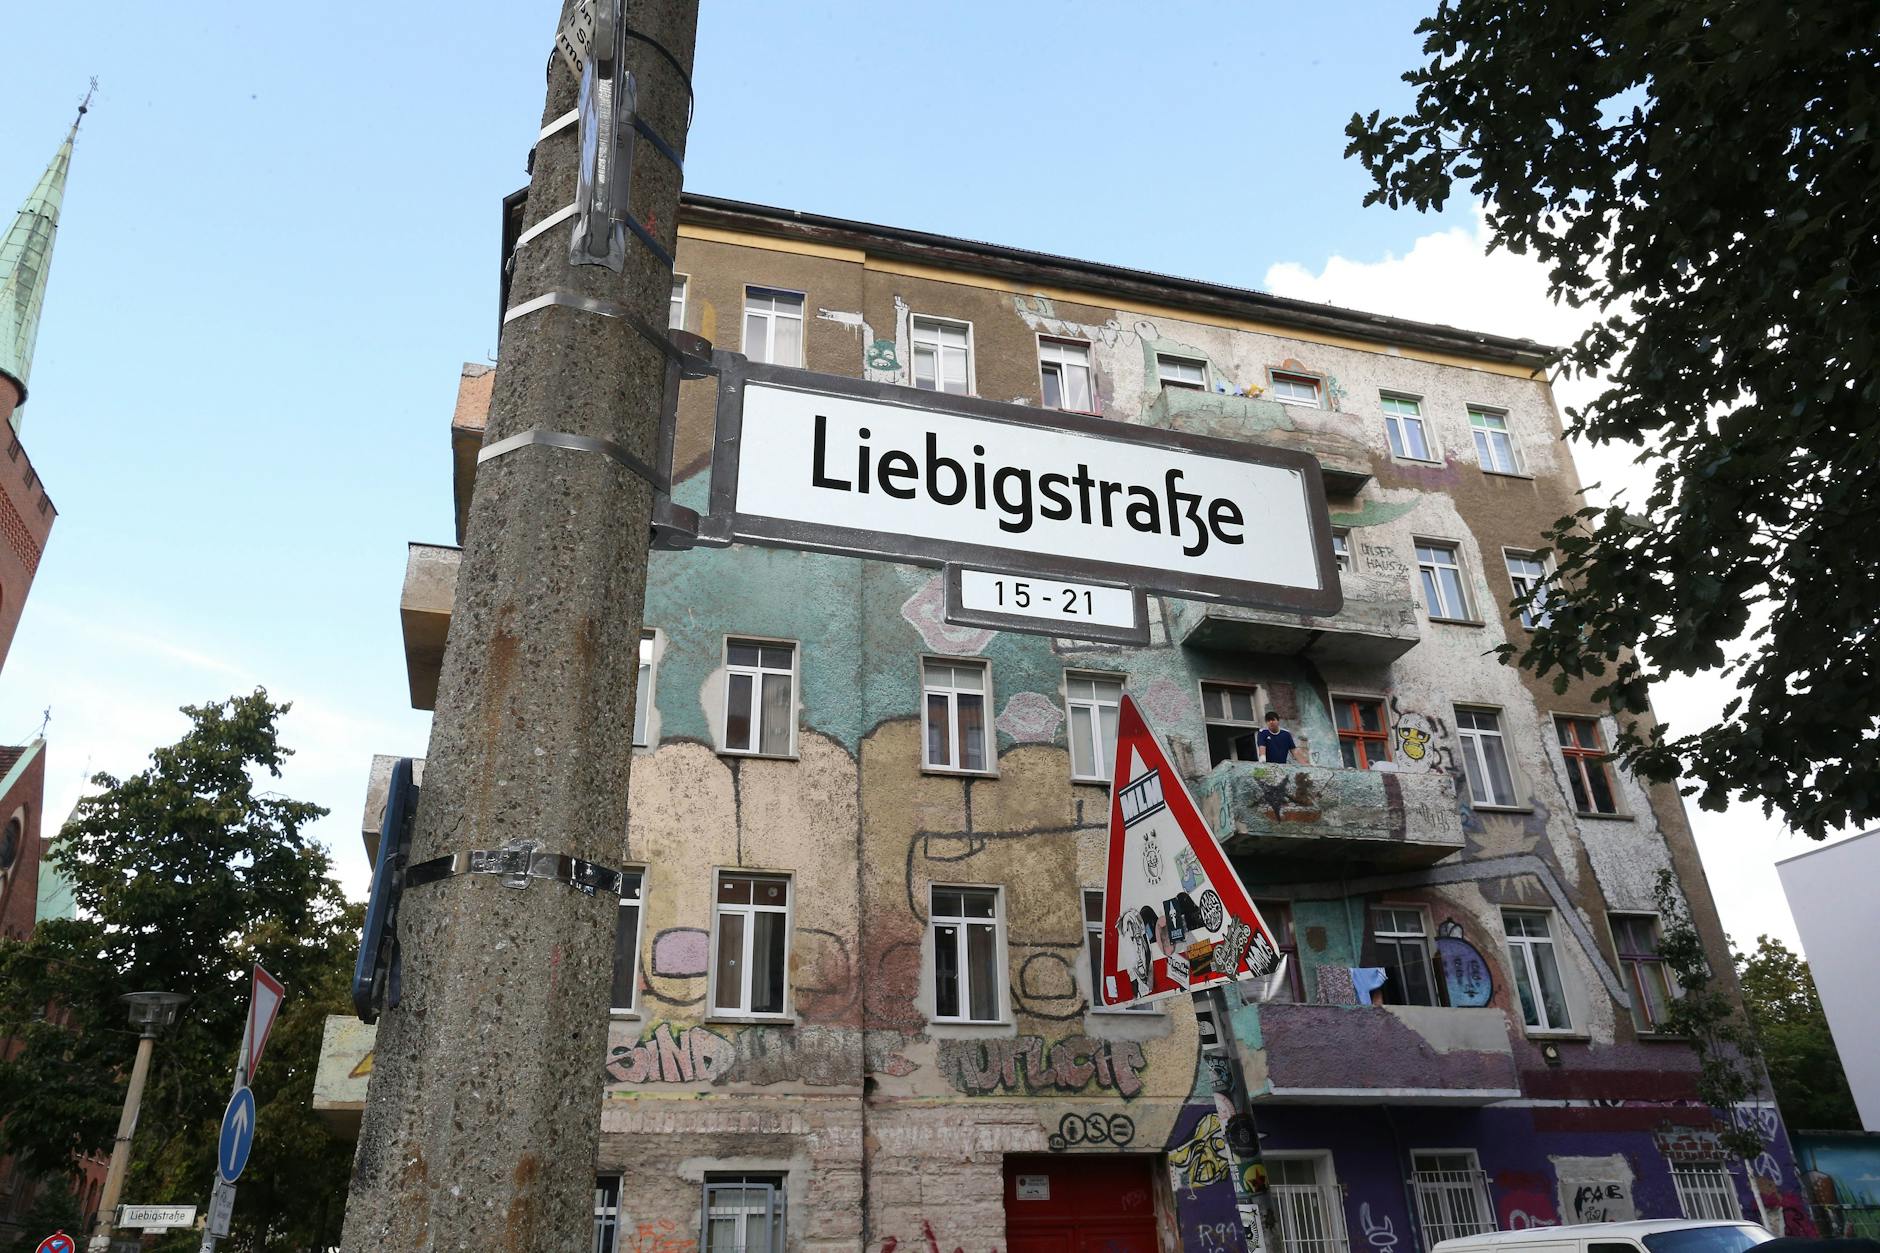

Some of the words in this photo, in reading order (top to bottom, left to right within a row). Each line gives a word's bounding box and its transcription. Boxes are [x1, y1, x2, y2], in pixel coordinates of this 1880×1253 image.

[812, 415, 1246, 557] Liebigstraße
[1119, 775, 1165, 823] MLM
[607, 1023, 736, 1084] SIND
[130, 1210, 186, 1223] Liebigstraße
